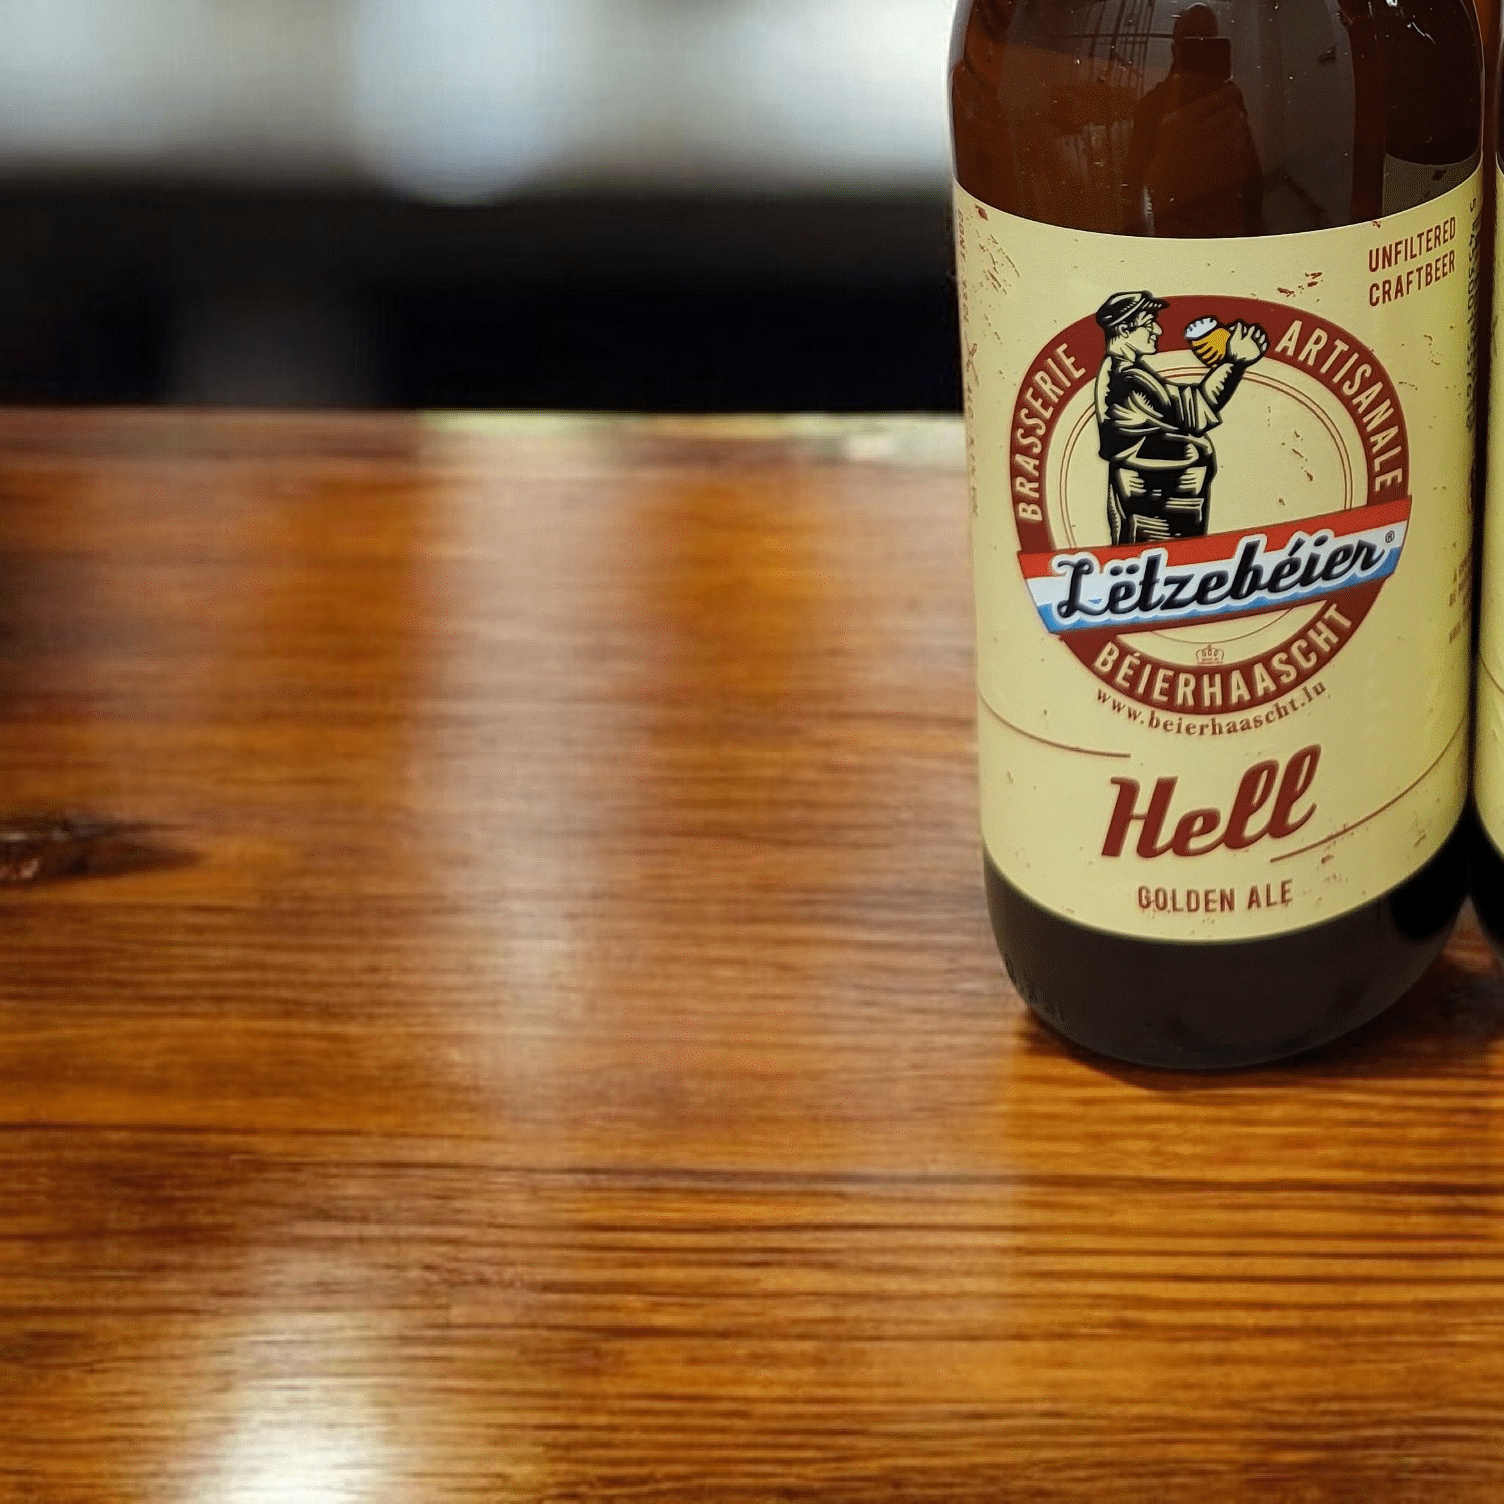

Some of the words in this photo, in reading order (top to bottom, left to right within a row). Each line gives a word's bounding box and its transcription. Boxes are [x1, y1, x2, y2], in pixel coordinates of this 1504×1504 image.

[1368, 216, 1457, 273] UNFILTERED
[1368, 249, 1456, 307] CRAFTBEER
[1018, 342, 1086, 521] BRASSERIE
[1275, 319, 1403, 493] ARTISANALE
[1094, 603, 1353, 707] BÉIERHAASCHT
[1095, 679, 1327, 737] www.beierhaascht.lu
[1100, 743, 1322, 859] Hell
[1136, 883, 1237, 912] GOLDEN
[1246, 877, 1294, 910] ALE
